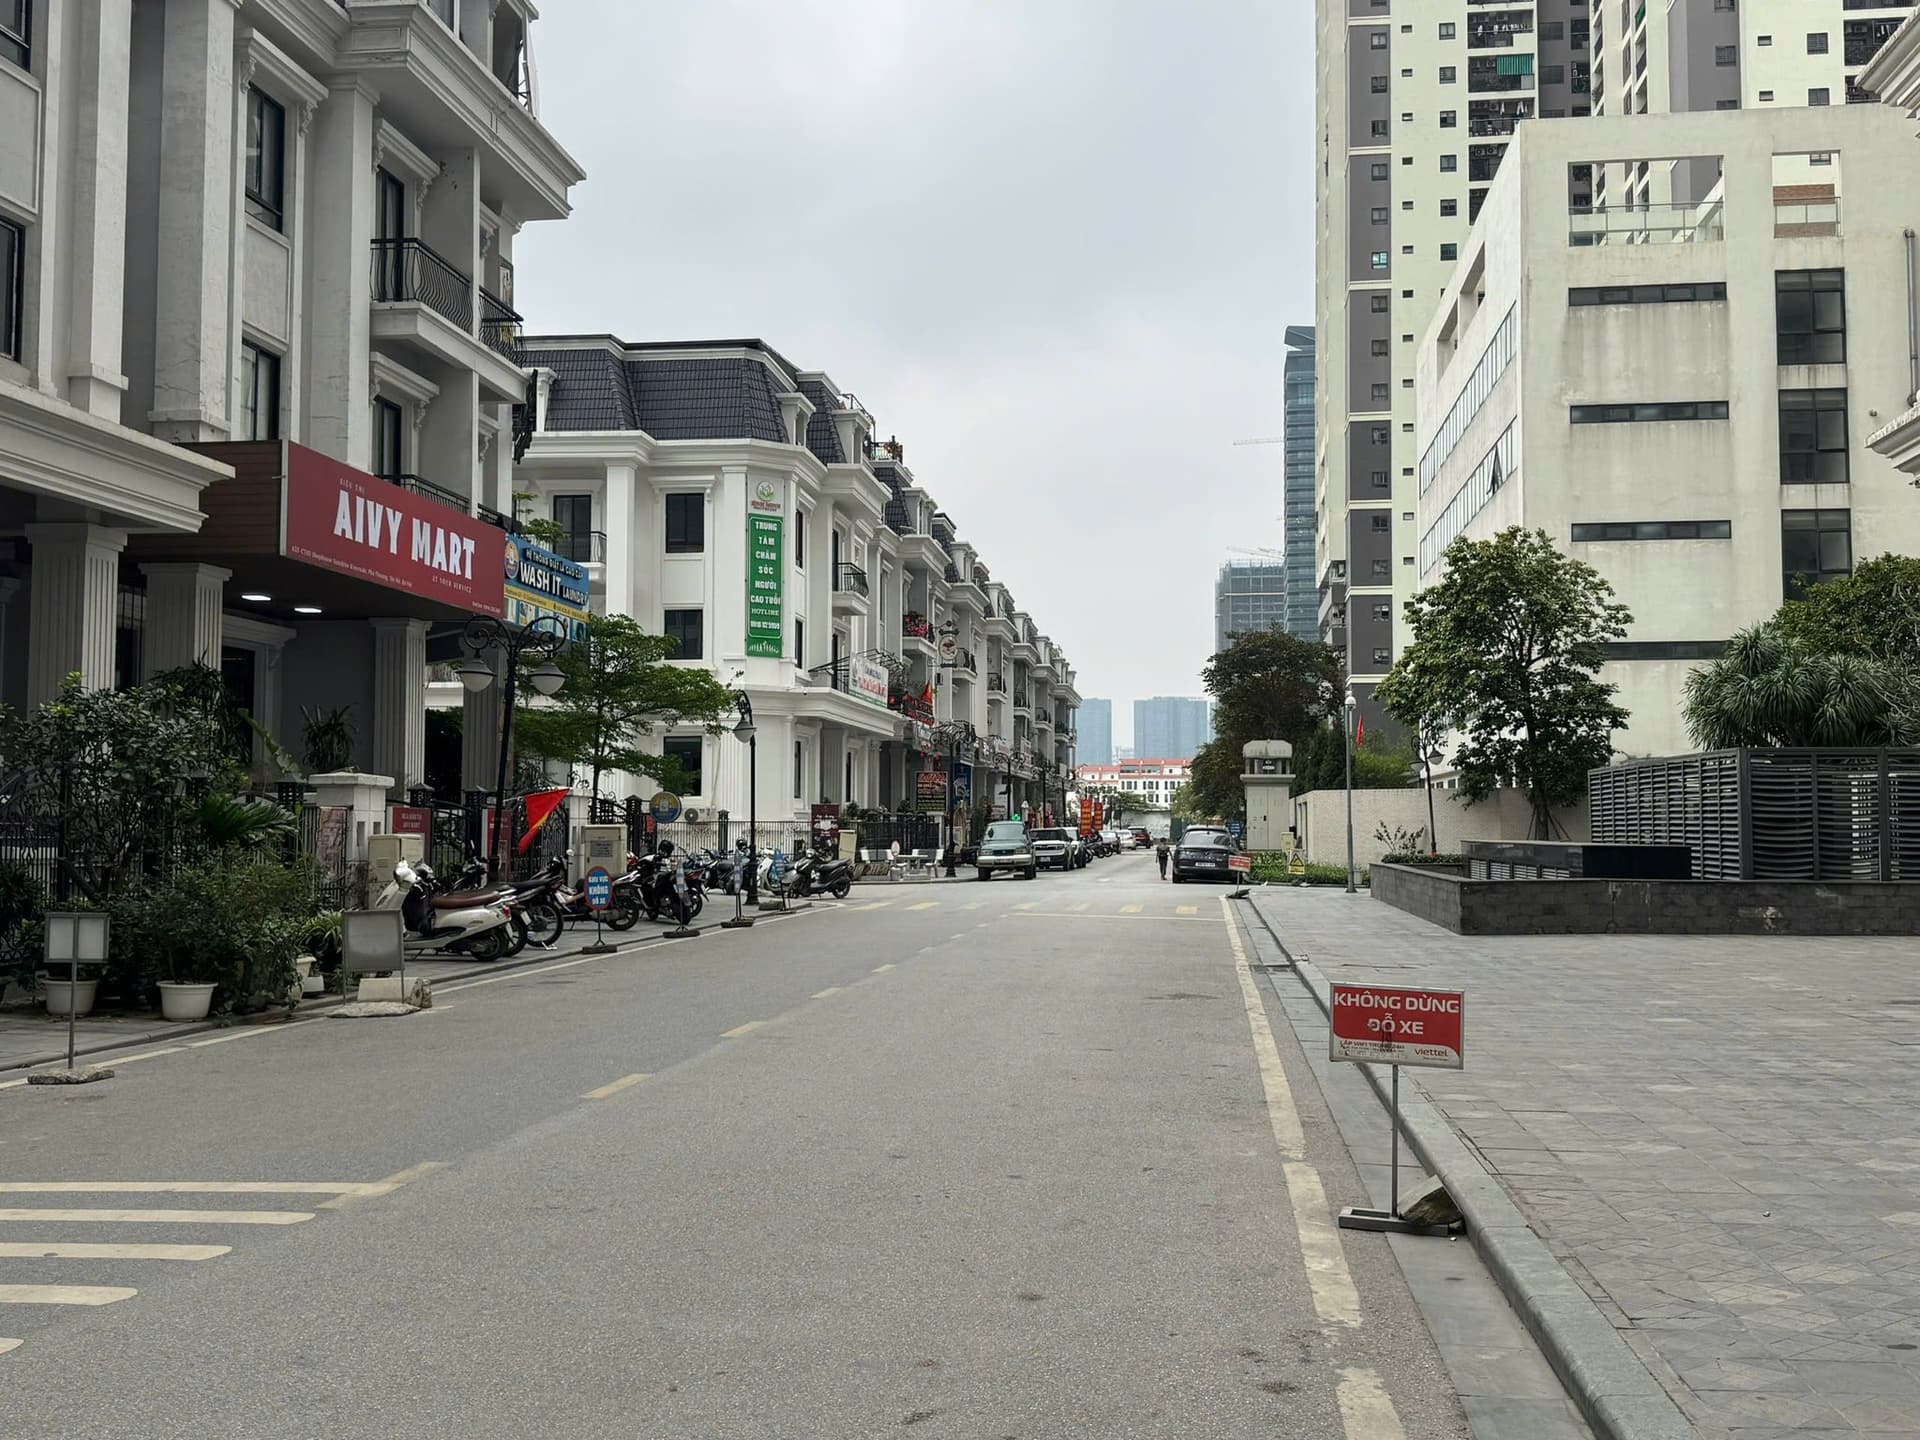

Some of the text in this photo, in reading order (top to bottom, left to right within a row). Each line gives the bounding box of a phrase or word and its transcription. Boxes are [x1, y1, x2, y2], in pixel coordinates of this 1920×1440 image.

[755, 521, 778, 532] TRUNG
[333, 489, 475, 580] AIVY MART
[758, 535, 775, 546] TÂM
[758, 564, 774, 575] SÓC
[520, 561, 550, 592] WASH
[552, 575, 562, 596] IT
[562, 586, 589, 605] LAUNDRY
[750, 595, 764, 604] CAO
[751, 607, 780, 616] HOTLINE
[1334, 991, 1460, 1013] KHÔNG DỪNG
[1367, 1012, 1424, 1035] ĐỖ XE
[1414, 1047, 1449, 1057] viettel
